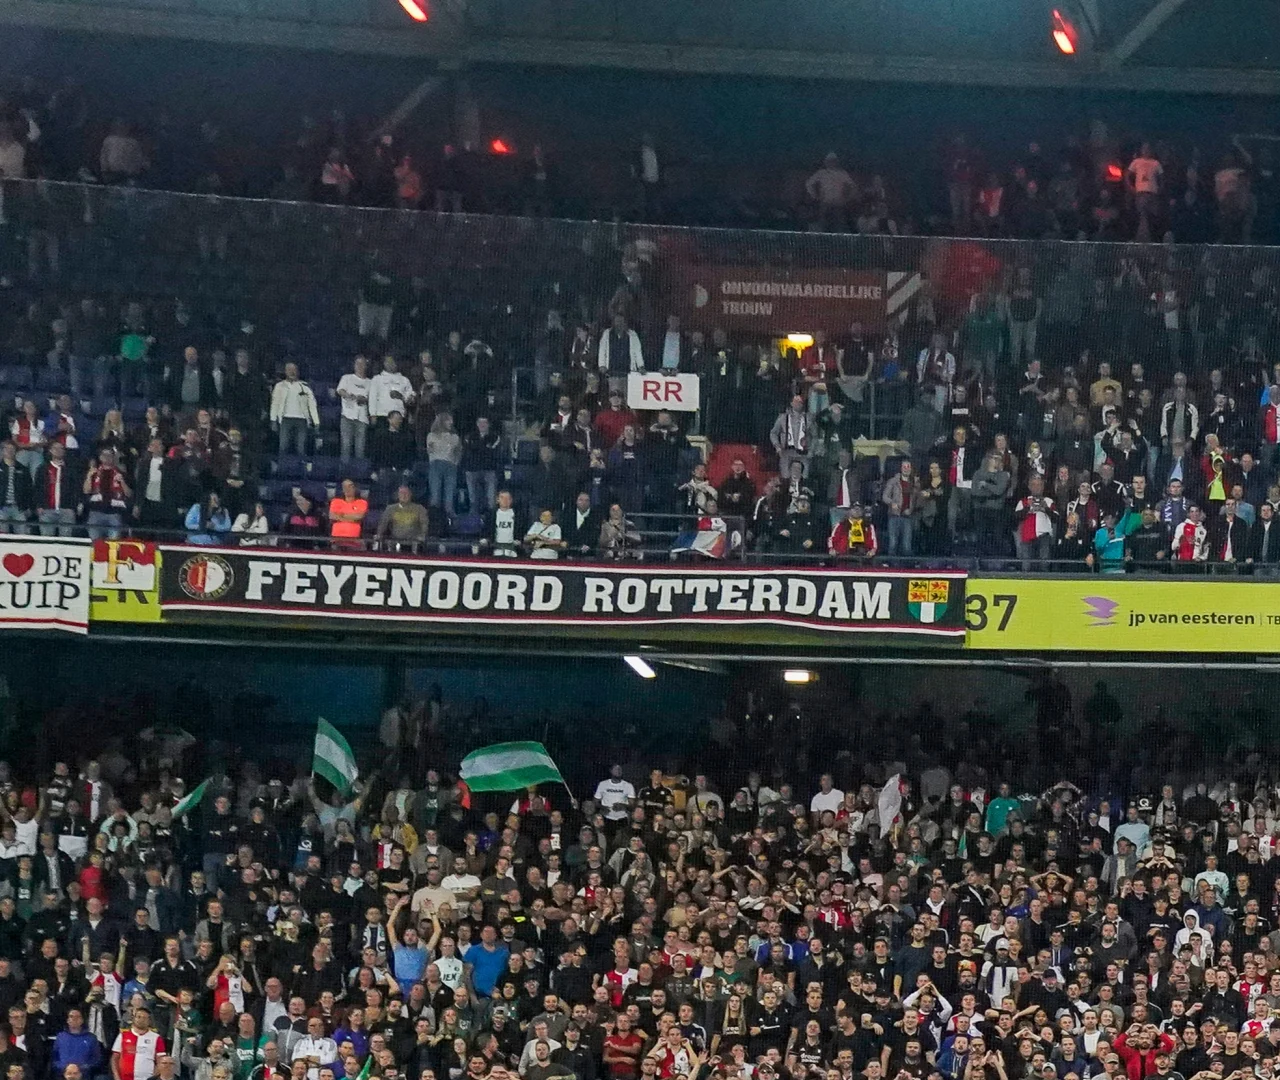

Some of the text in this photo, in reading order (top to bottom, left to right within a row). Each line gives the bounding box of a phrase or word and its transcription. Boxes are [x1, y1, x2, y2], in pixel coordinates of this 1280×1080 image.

[642, 380, 684, 402] RR
[43, 555, 82, 580] DE
[244, 559, 564, 612] FEYENOORD
[582, 576, 892, 620] ROTTERDAM
[1128, 610, 1146, 627] jp
[1149, 613, 1178, 625] van
[1181, 612, 1255, 626] eesteren
